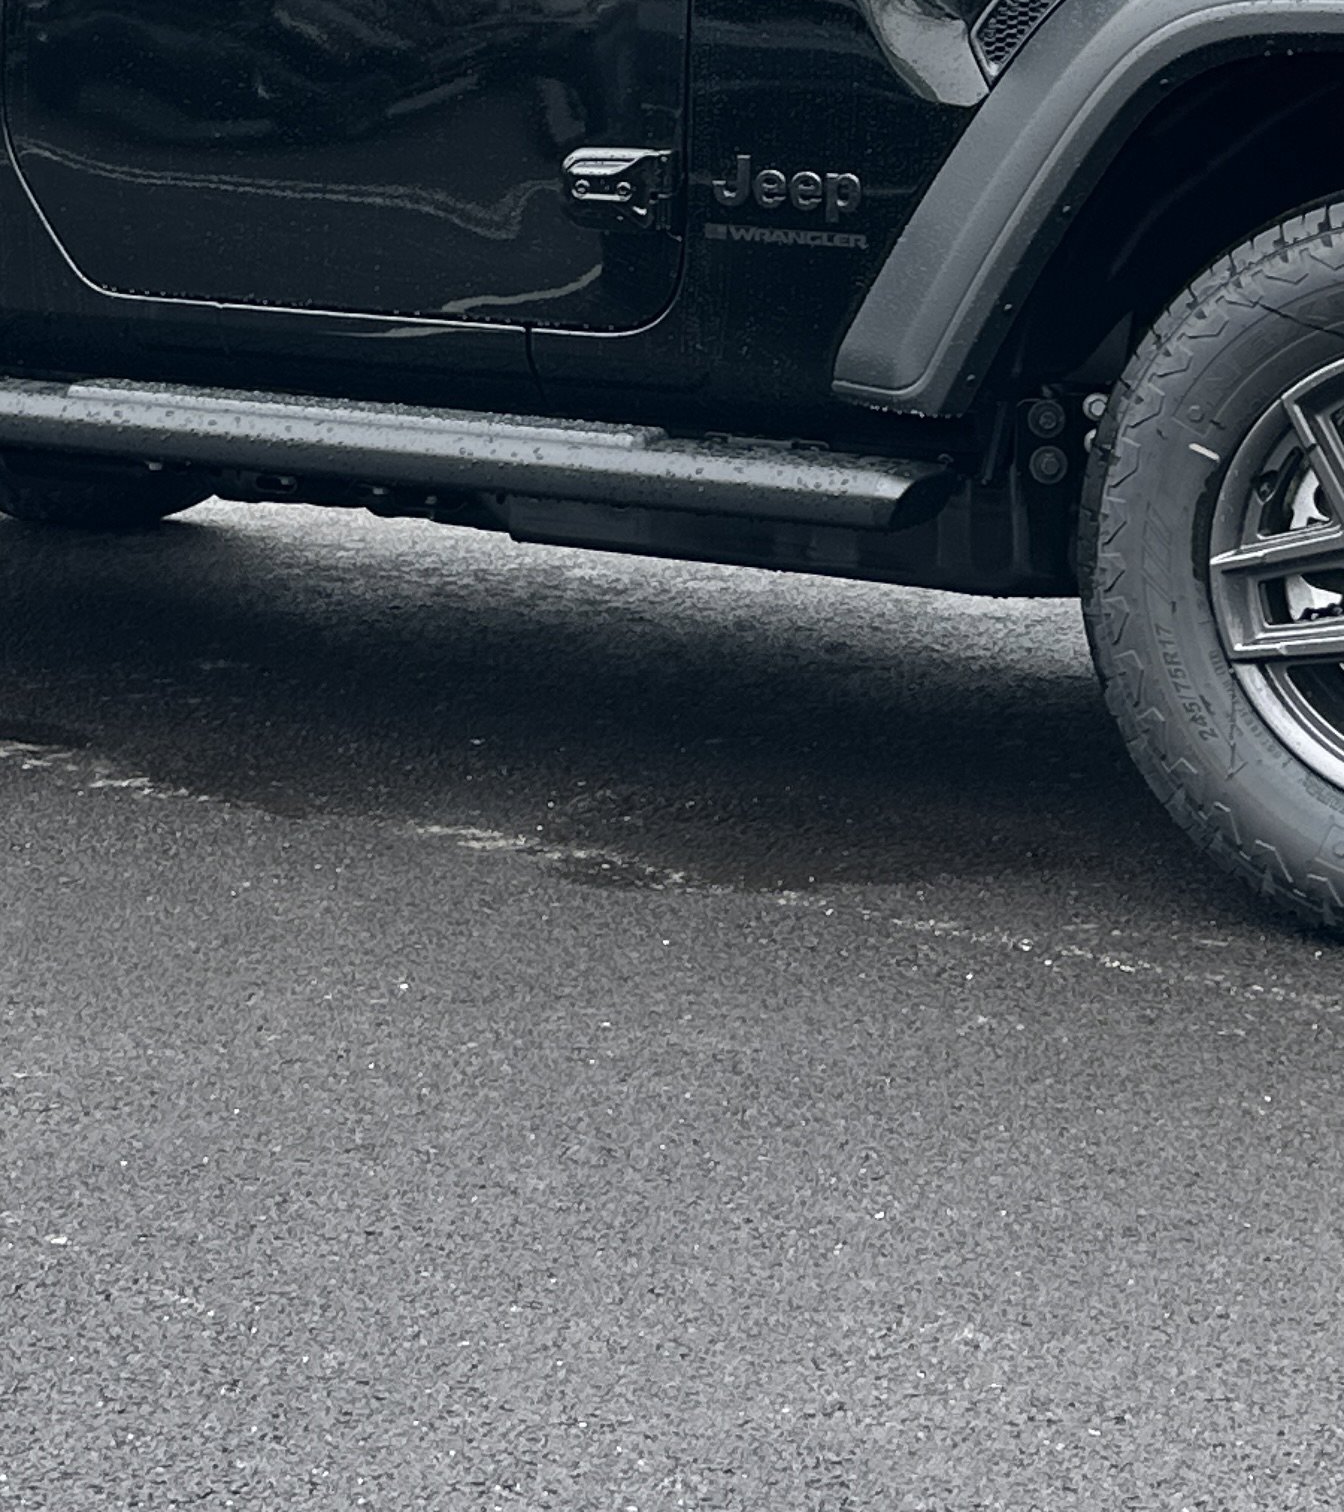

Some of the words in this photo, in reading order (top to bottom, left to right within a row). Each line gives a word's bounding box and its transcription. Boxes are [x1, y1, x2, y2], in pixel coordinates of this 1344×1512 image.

[711, 153, 863, 224] Jeep
[728, 224, 870, 251] WRANGLER
[1155, 621, 1218, 746] 245/75R17
